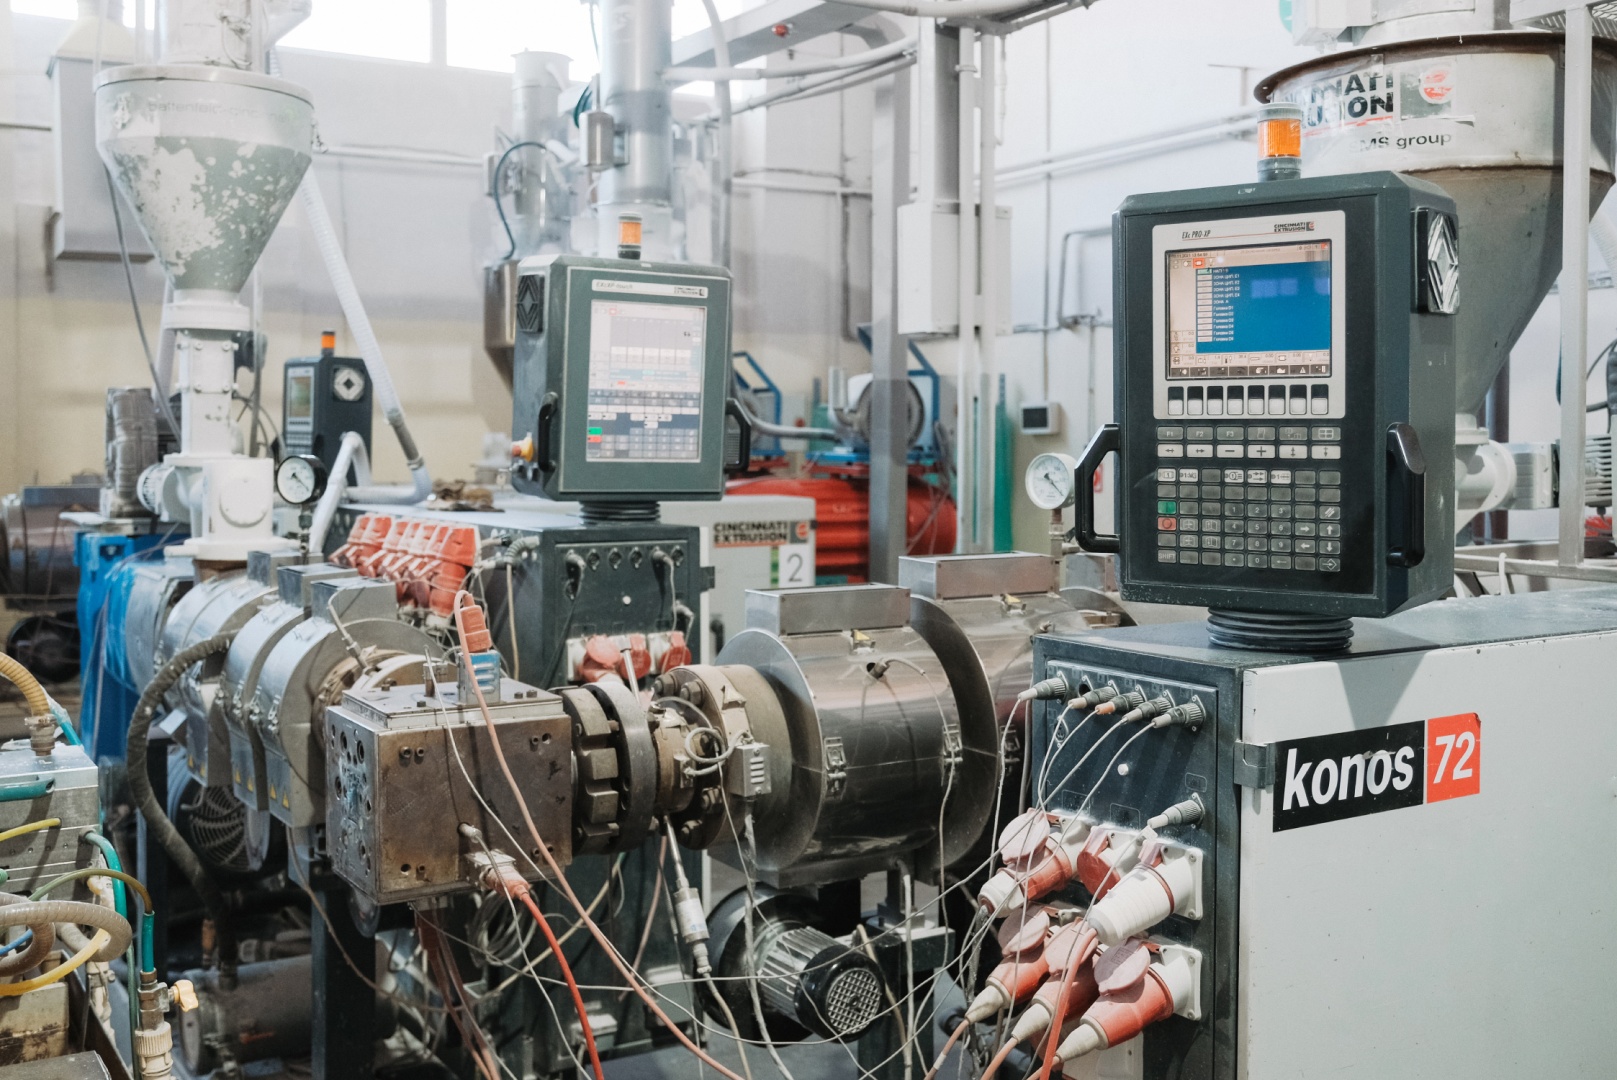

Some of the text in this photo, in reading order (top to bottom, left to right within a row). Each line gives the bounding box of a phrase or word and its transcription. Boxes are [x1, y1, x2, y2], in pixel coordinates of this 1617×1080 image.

[1396, 133, 1452, 150] group
[1273, 221, 1306, 229] CINCINNATI
[713, 521, 788, 532] CINCINNATI
[713, 531, 788, 544] EXTRUSION
[786, 553, 803, 582] 2
[1282, 731, 1476, 811] konos 72
